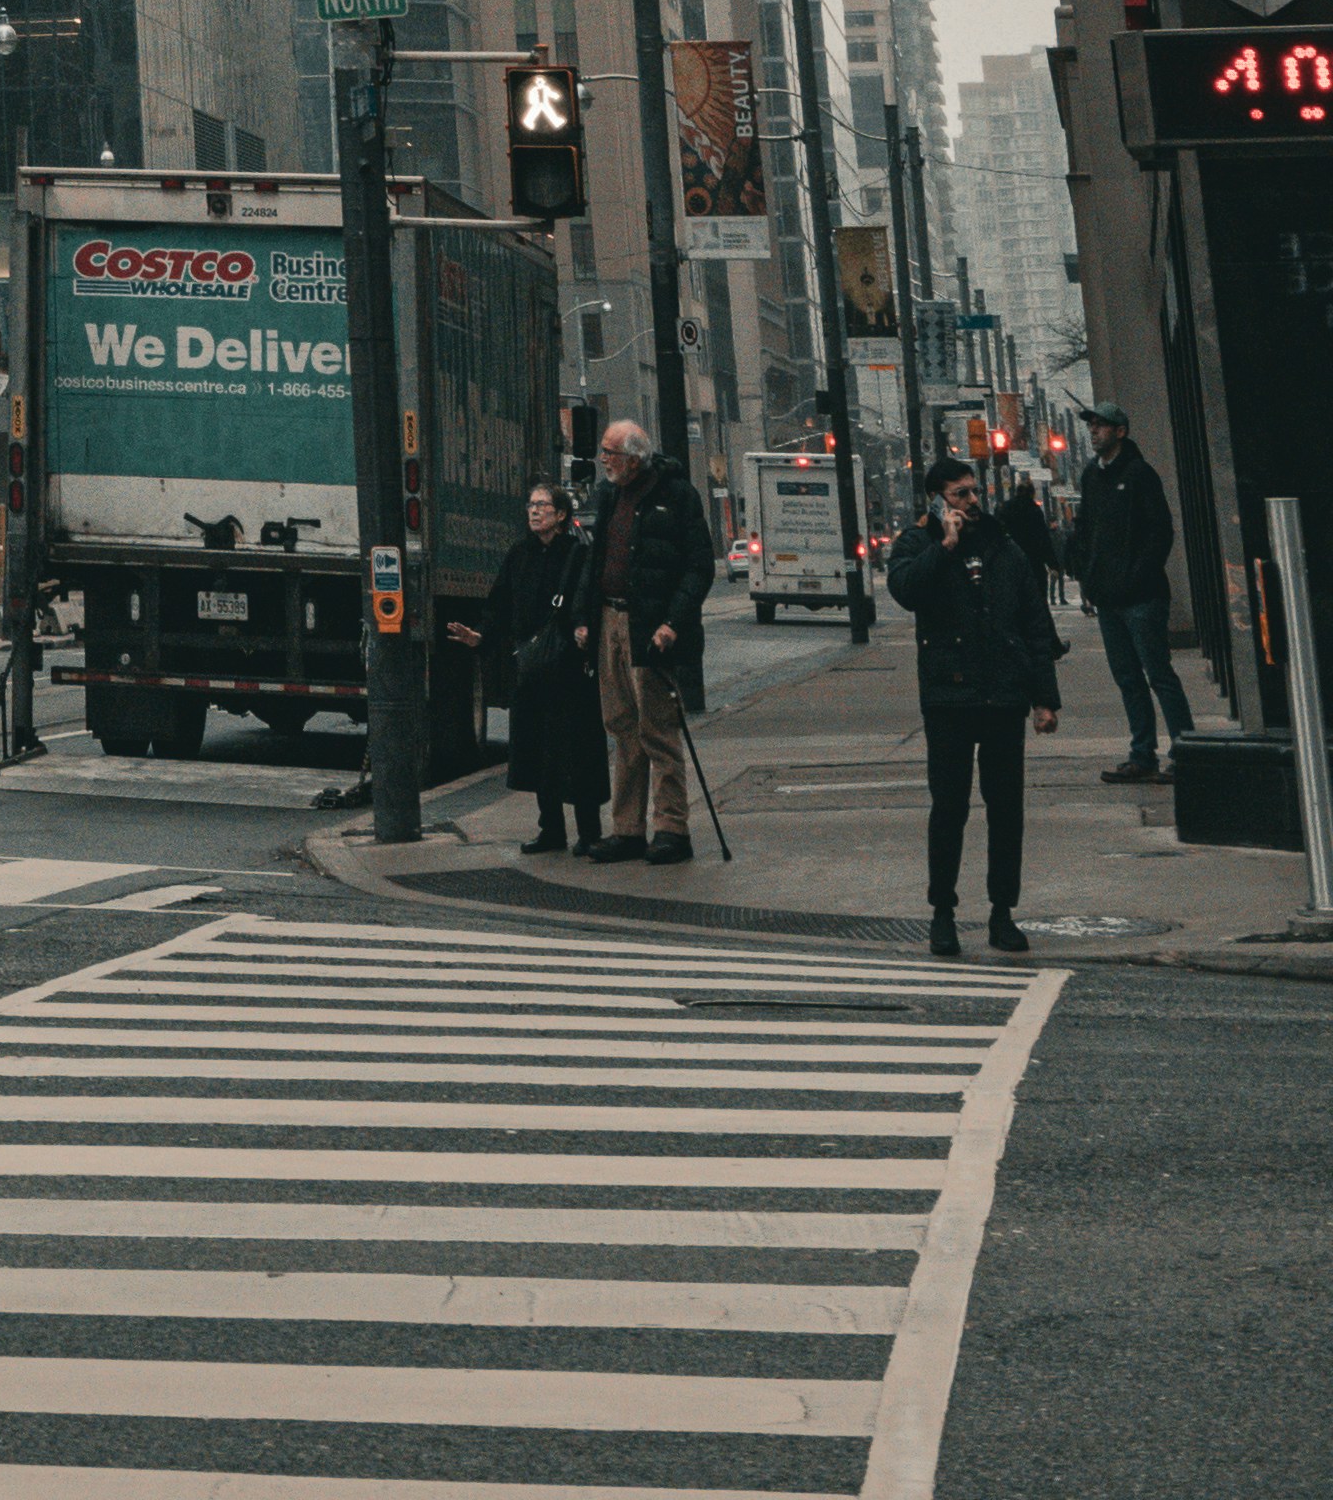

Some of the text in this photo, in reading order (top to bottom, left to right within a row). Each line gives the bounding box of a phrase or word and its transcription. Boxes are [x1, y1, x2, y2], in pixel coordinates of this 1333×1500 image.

[241, 207, 278, 218] 224824
[74, 239, 255, 283] COSTCO
[271, 252, 346, 279] Busine
[130, 280, 250, 299] WHOLESALE
[270, 278, 348, 303] Centre
[85, 323, 166, 368] We
[54, 374, 352, 399] costcobusinesscentre.ca 1-866-455-
